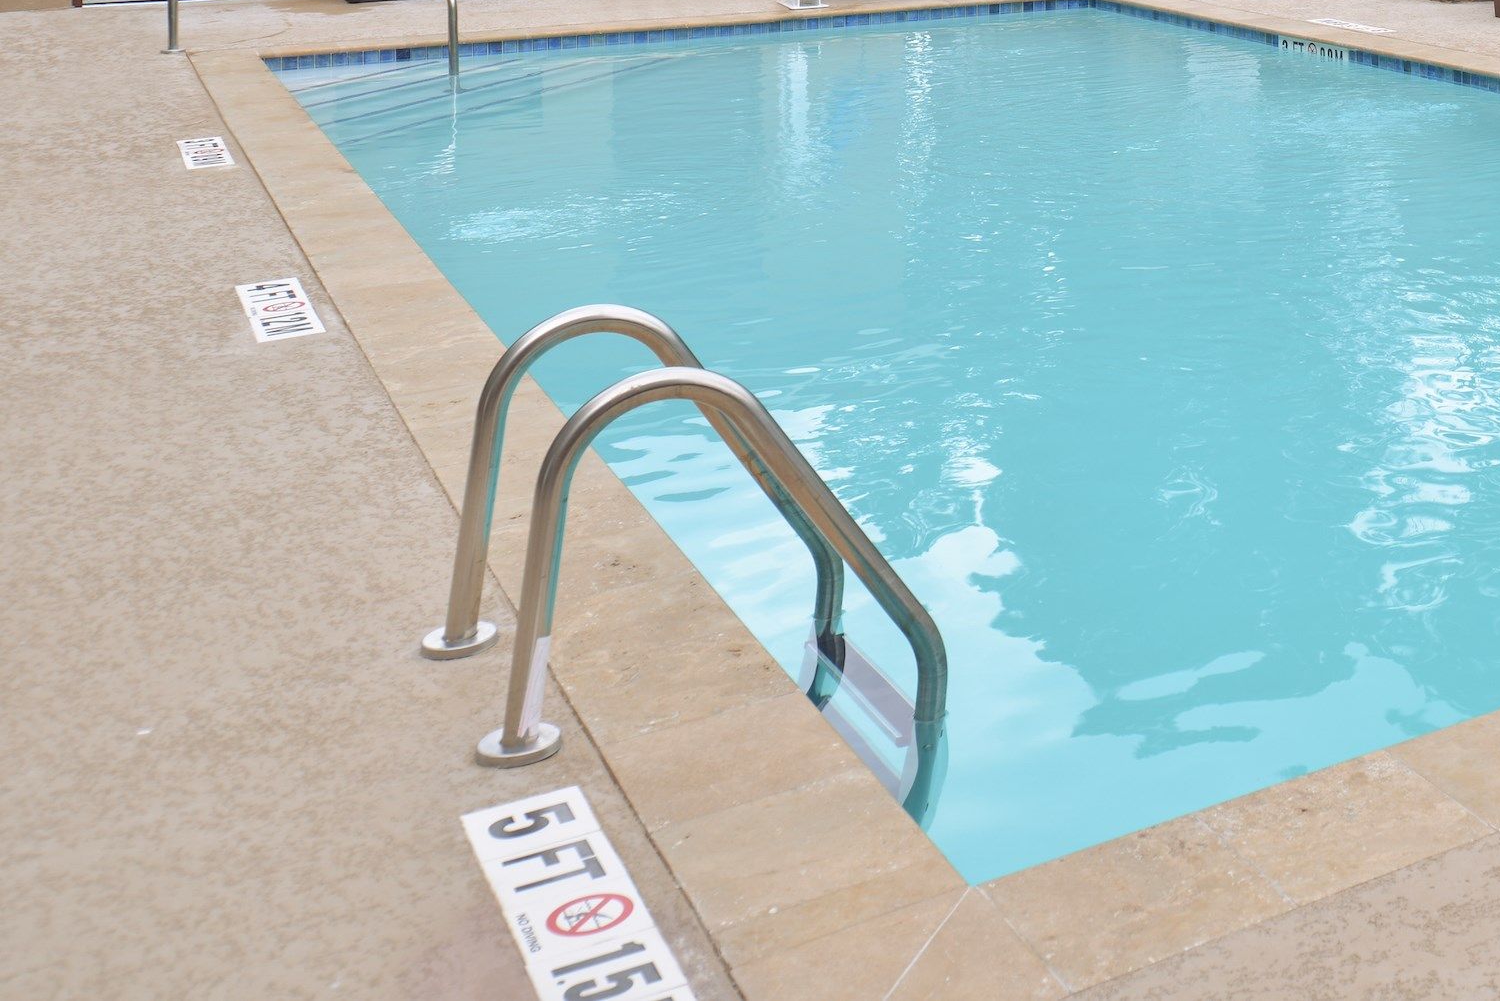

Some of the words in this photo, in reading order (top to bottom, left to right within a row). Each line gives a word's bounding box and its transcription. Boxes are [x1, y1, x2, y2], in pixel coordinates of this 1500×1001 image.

[247, 283, 290, 292] 4
[249, 289, 297, 304] FT
[487, 801, 576, 840] 5
[501, 838, 607, 893] FT
[515, 911, 527, 928] NO
[520, 921, 542, 954] DIVING
